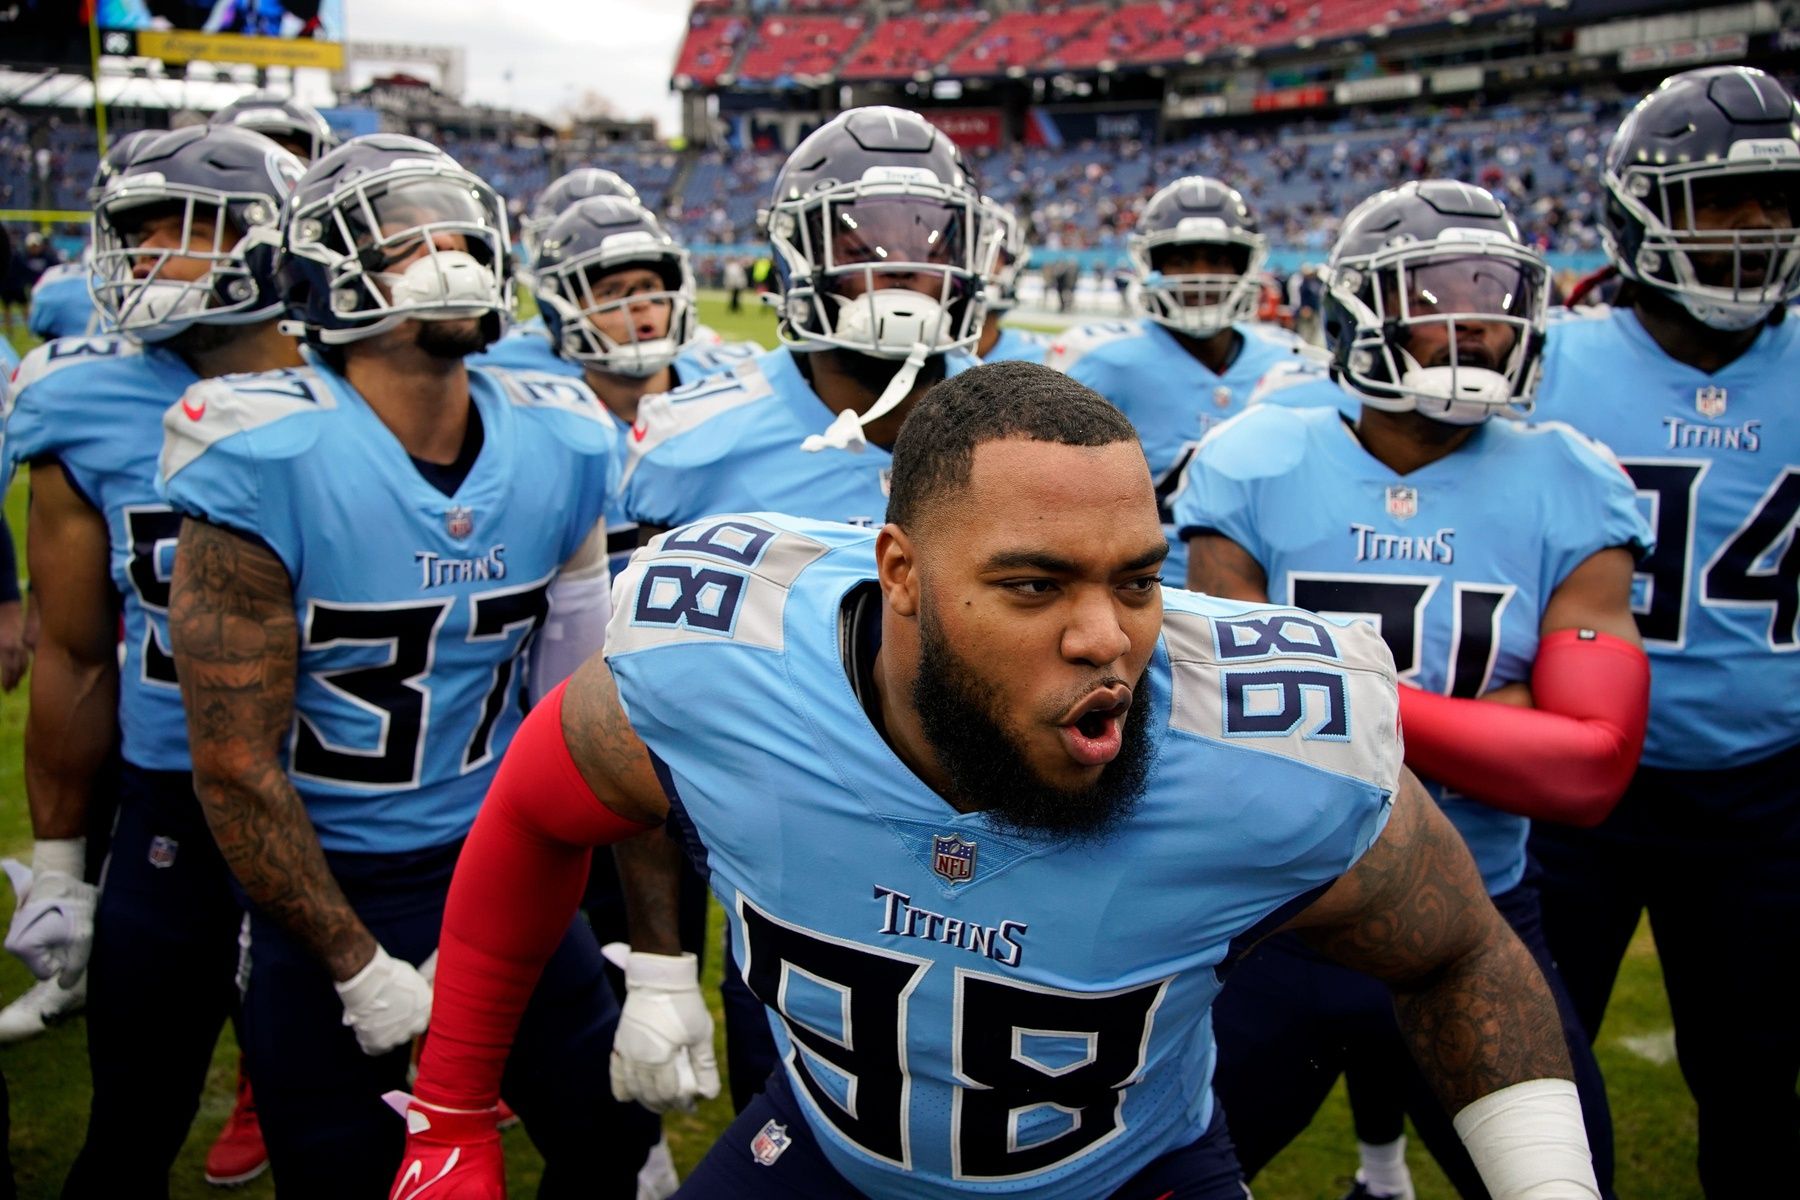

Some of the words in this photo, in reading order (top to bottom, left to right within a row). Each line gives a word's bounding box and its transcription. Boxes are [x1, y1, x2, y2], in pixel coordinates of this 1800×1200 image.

[1663, 415, 1762, 452] TITANS
[415, 544, 507, 590] TITANS
[630, 519, 782, 638] 98
[1350, 522, 1456, 565] TITANS
[288, 575, 553, 790] 37
[1209, 614, 1352, 743] 98
[937, 854, 967, 876] NFL
[873, 884, 1028, 968] TITANS
[735, 889, 1179, 1183] 98
